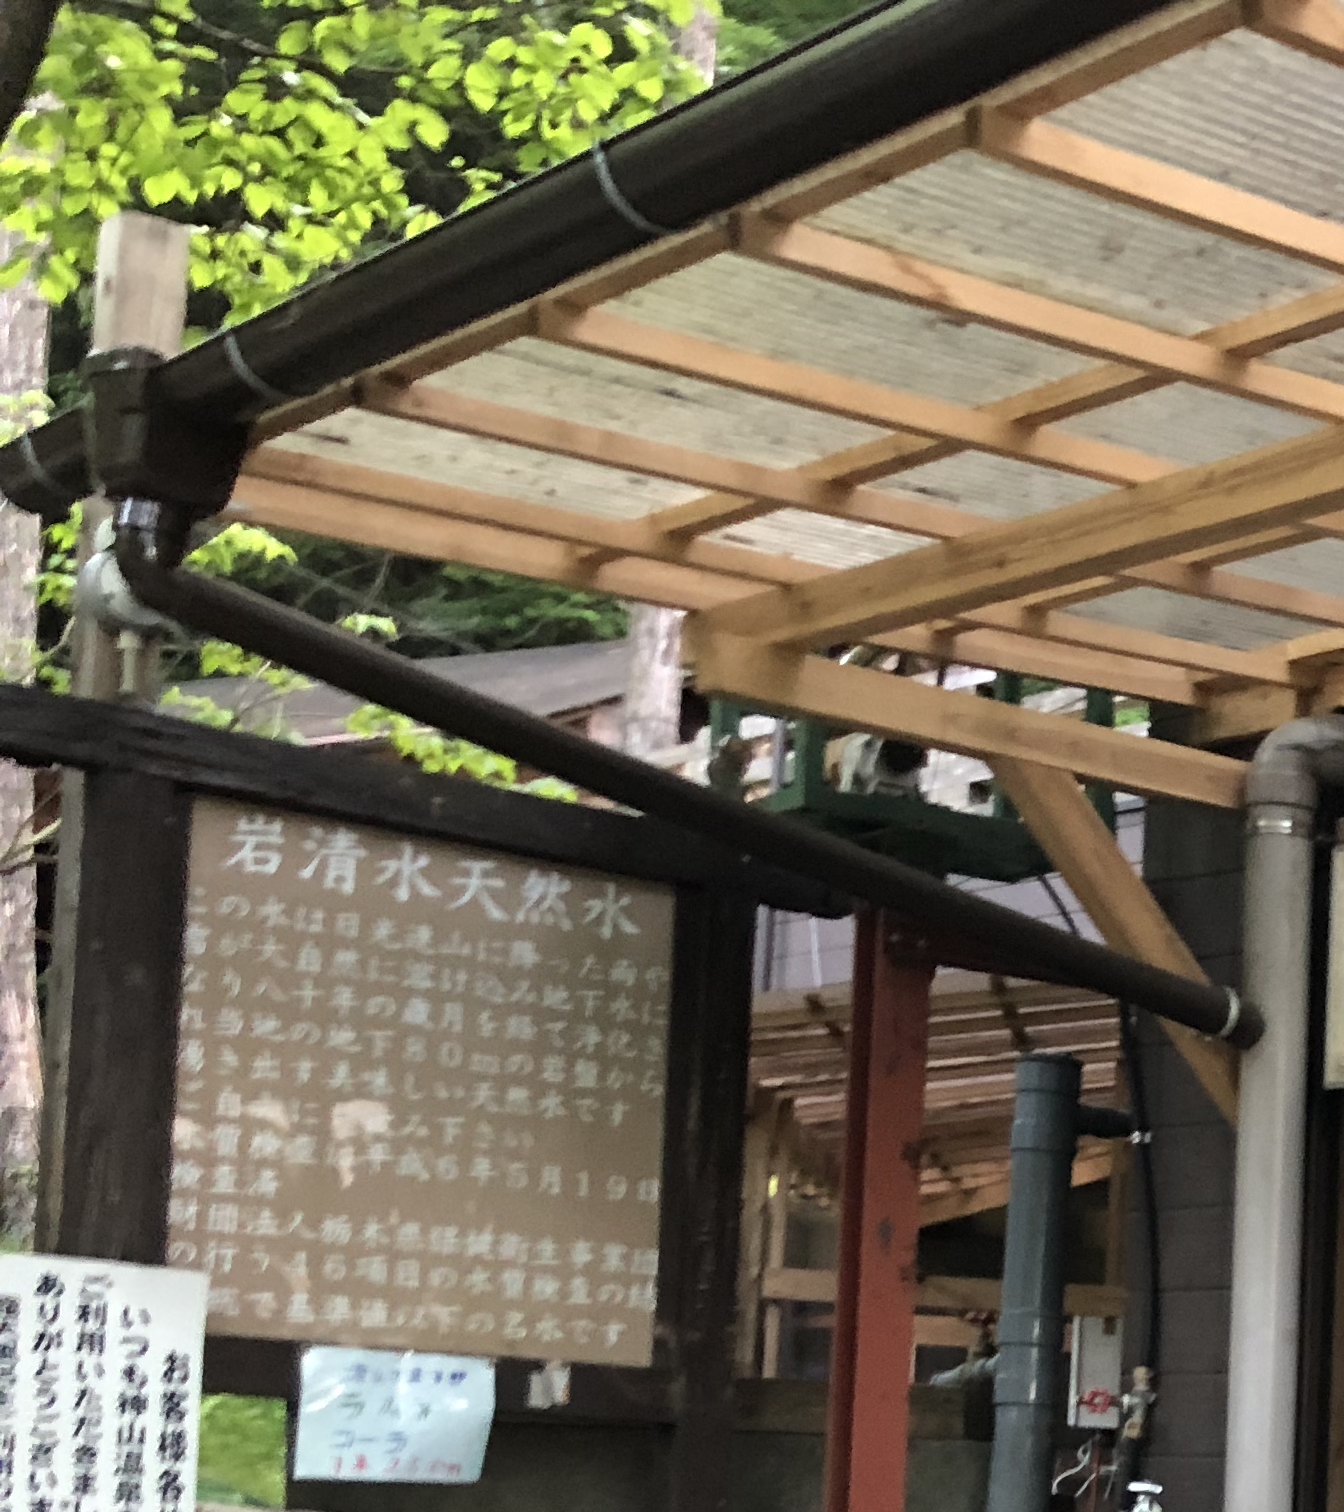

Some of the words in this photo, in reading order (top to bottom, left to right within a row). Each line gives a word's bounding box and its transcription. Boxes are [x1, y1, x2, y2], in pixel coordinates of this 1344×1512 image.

[222, 814, 641, 939] 岩清水天然水
